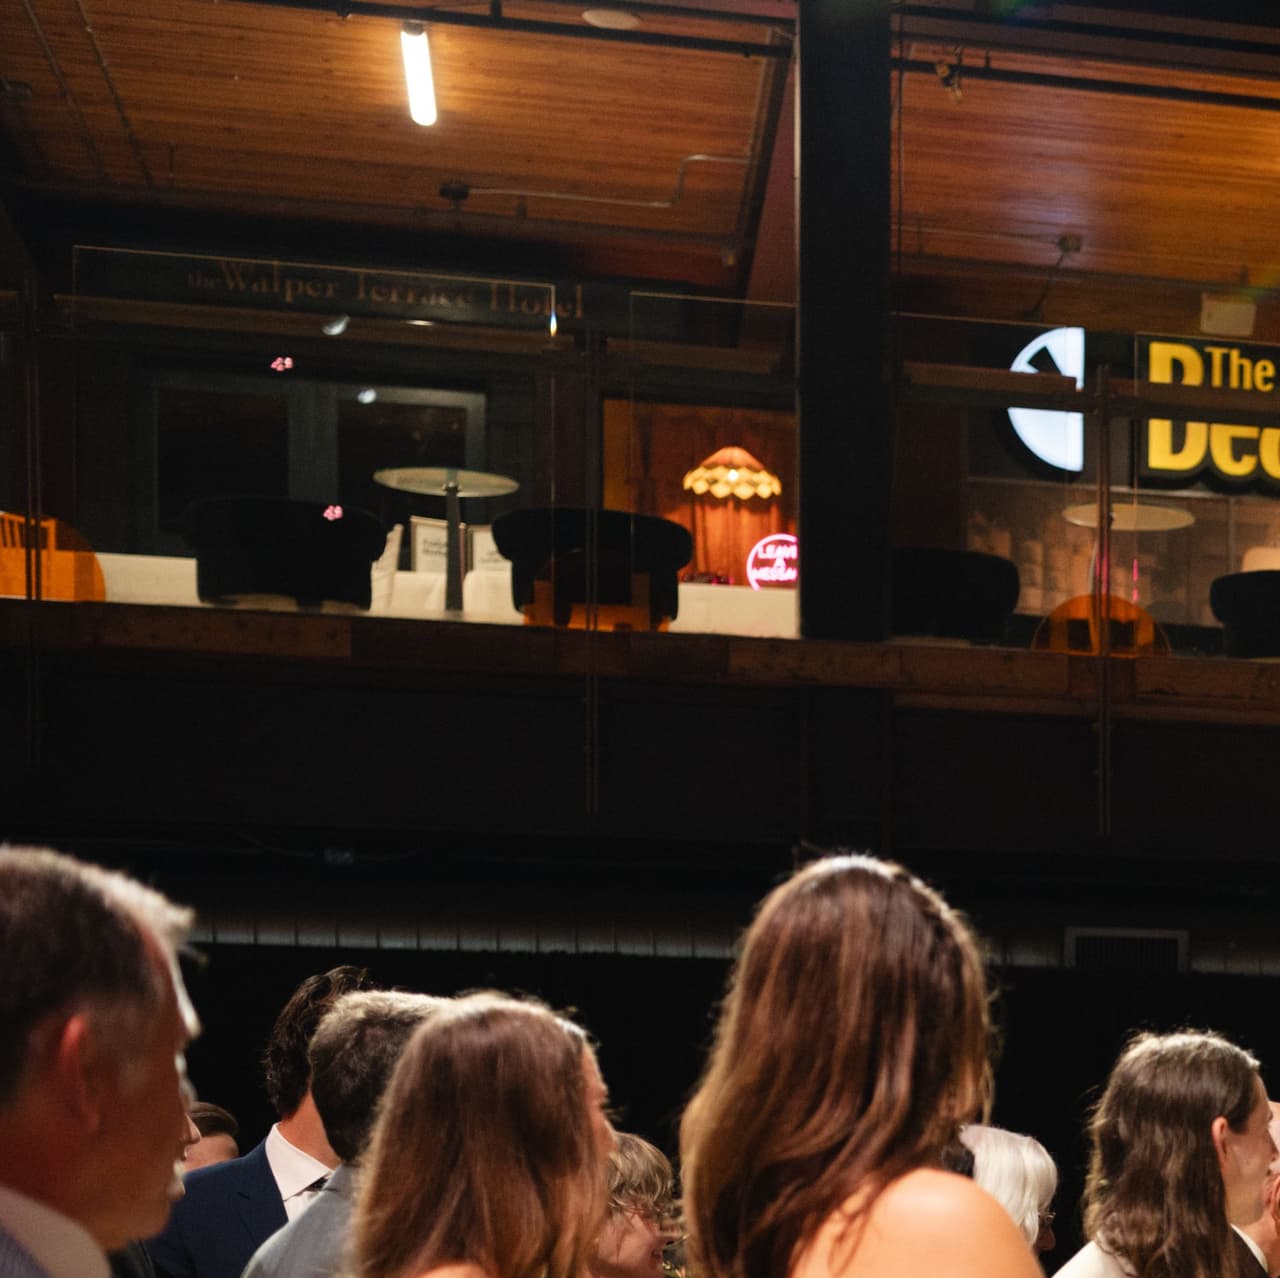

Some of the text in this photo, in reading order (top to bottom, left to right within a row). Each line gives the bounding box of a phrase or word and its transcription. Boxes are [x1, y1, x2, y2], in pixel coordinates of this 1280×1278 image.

[220, 259, 337, 303] Walper
[354, 267, 470, 306] Terrace
[1204, 346, 1276, 392] The
